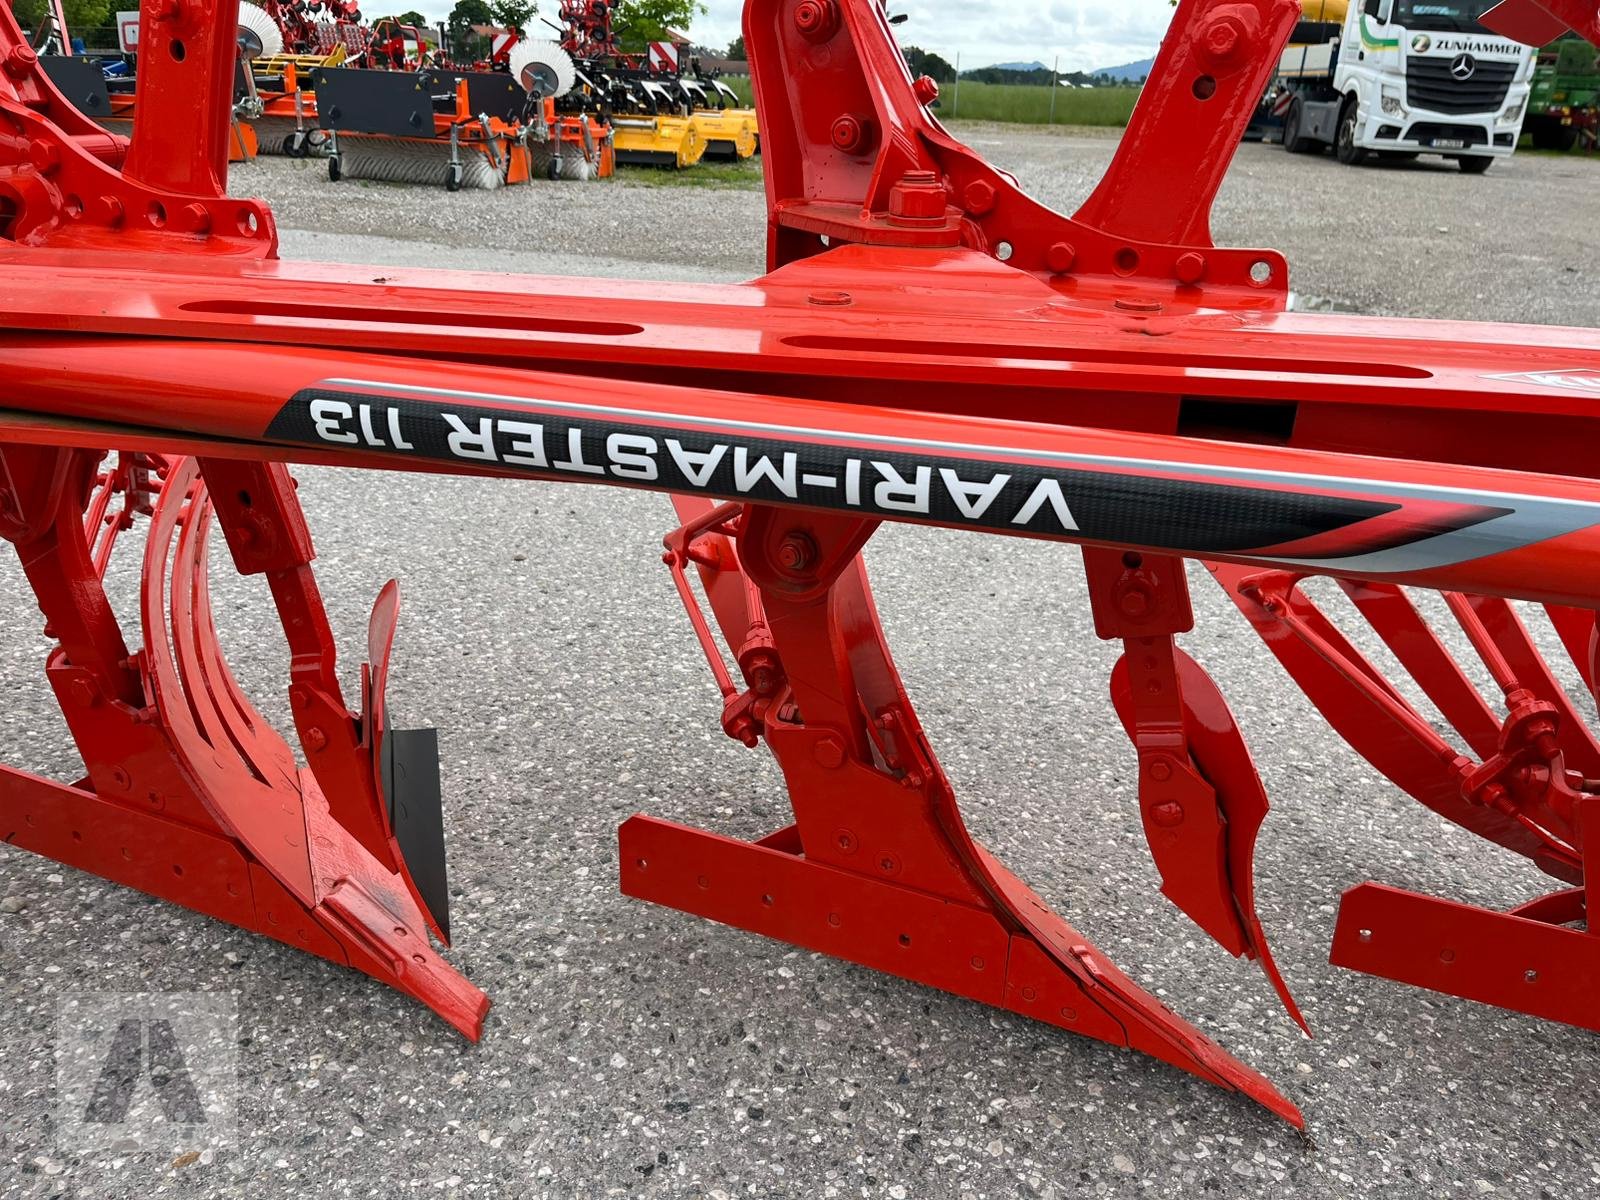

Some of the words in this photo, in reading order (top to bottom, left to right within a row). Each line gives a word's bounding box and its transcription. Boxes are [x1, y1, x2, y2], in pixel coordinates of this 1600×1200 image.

[1436, 40, 1522, 55] ZUNHAMMER
[309, 399, 415, 450] 113
[440, 412, 1080, 531] VARI-MASTER
